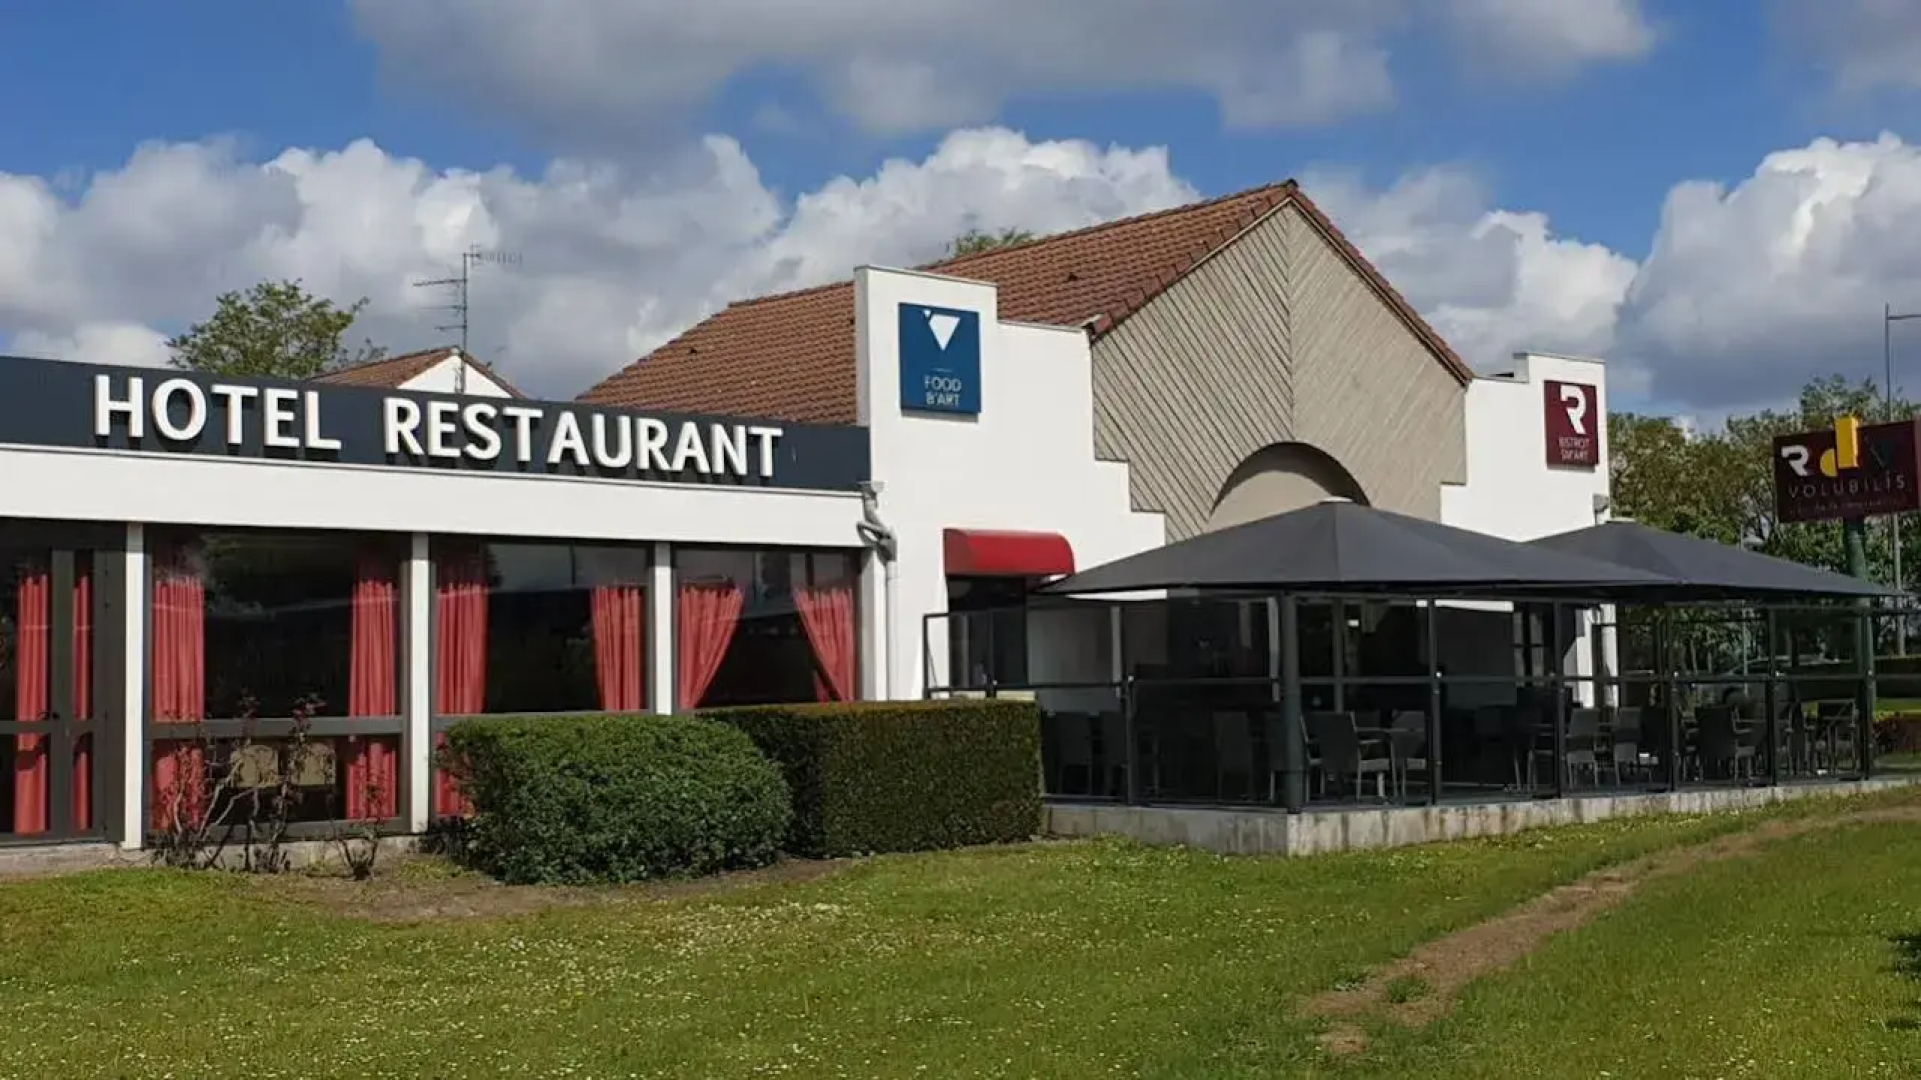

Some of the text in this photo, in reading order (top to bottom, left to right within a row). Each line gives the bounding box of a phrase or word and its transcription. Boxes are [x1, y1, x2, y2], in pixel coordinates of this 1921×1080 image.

[924, 375, 962, 393] FOOD
[95, 374, 782, 477] HOTEL RESTAURANT
[1560, 384, 1587, 434] R
[1788, 471, 1906, 498] VOLUBILIS
